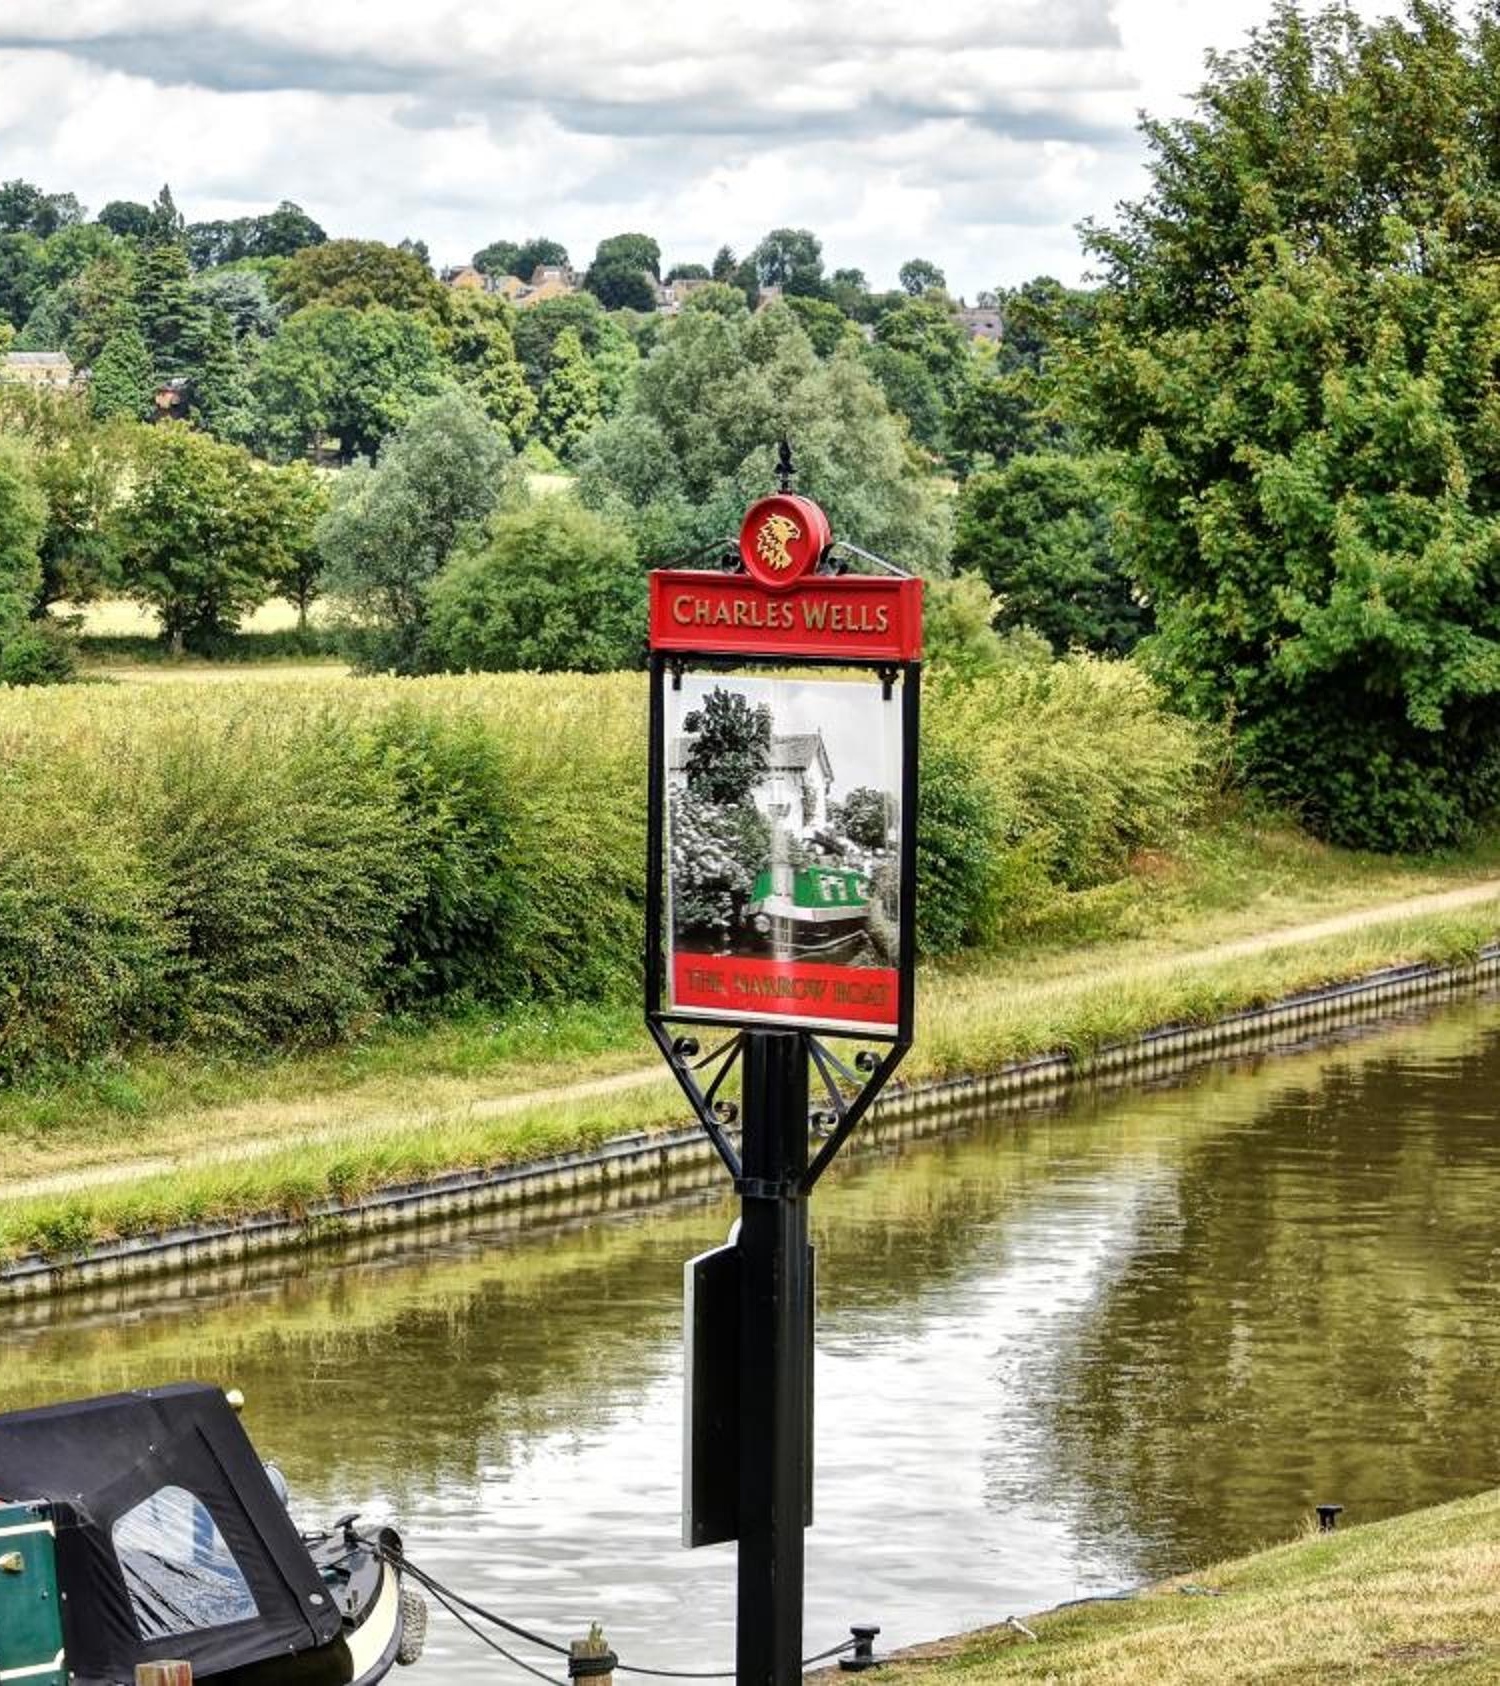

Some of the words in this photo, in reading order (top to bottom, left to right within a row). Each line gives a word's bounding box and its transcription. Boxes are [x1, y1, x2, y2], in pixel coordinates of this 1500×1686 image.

[672, 595, 795, 629] CHARLES
[801, 599, 889, 633] WELLS
[686, 968, 726, 994] THE
[732, 972, 829, 1002] NARROW
